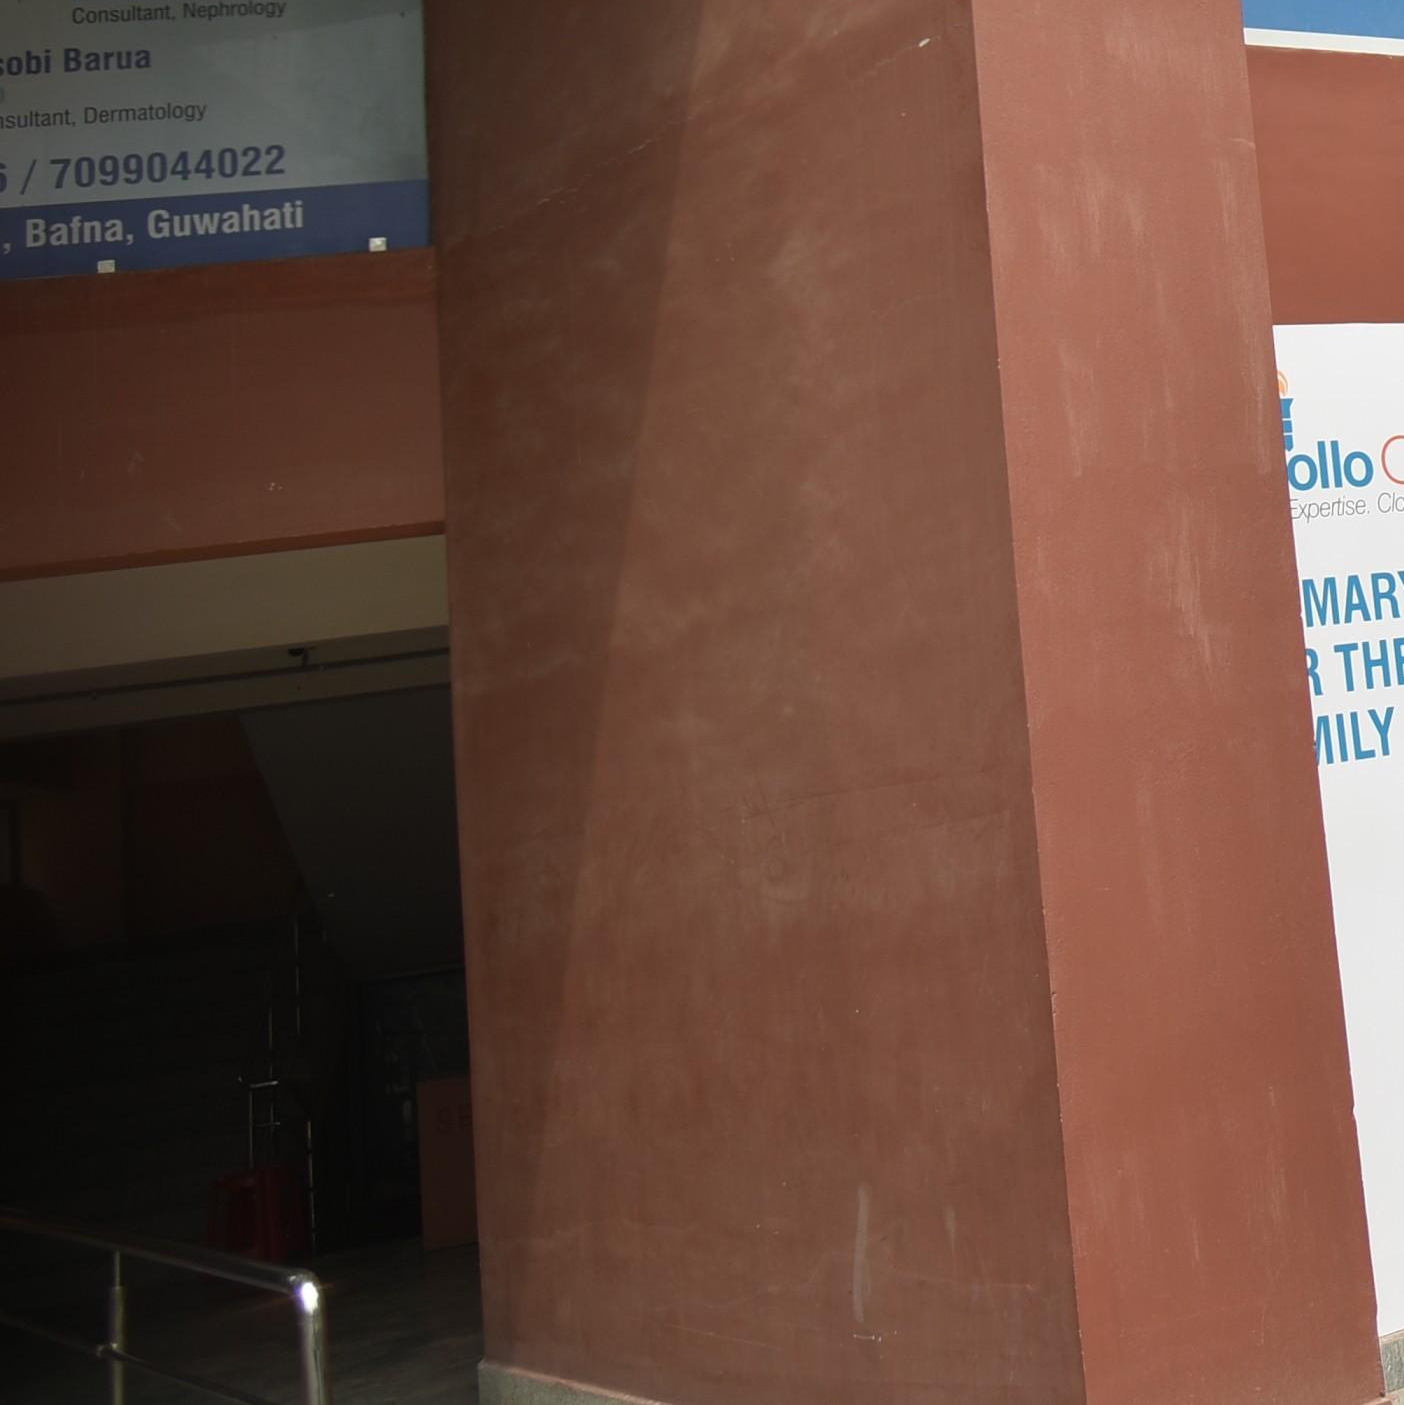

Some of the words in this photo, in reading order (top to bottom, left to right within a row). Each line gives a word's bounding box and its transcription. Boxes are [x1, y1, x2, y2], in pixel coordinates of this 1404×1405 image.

[72, 7, 176, 24] Consultant,
[183, 0, 287, 20] Nephrology
[63, 48, 152, 73] Barua
[50, 144, 286, 190] 7099044022
[25, 217, 135, 249] Bafna,
[147, 200, 305, 239] Guwahati
